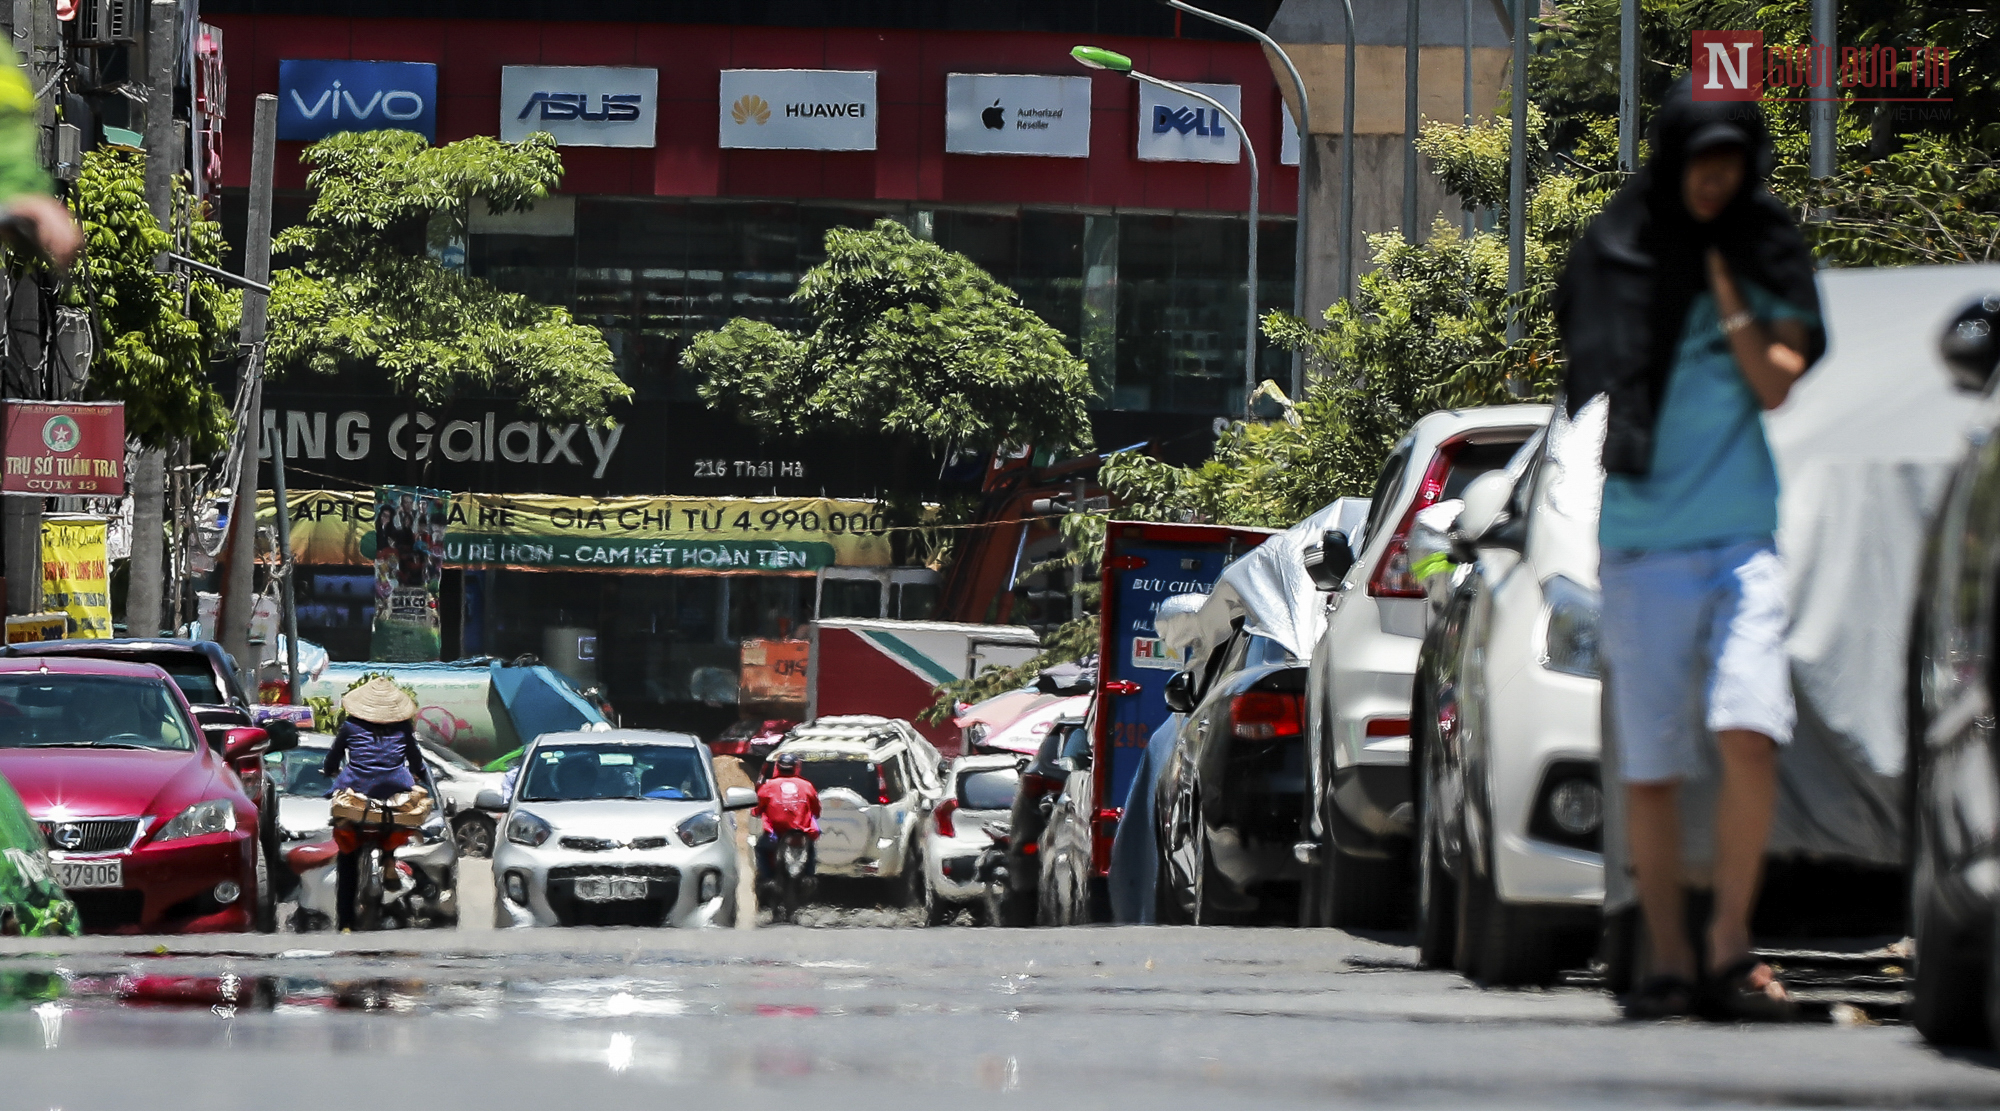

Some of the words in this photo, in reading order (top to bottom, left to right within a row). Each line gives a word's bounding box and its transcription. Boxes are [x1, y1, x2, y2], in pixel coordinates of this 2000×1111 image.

[517, 92, 642, 121] ASUS
[786, 103, 865, 118] HUAWEI
[1017, 107, 1063, 119] Authorized
[1016, 120, 1049, 130] Reseller
[1153, 105, 1225, 136] DELL
[388, 411, 625, 479] Galaxy
[6, 456, 31, 479] TRỤ
[34, 450, 53, 475] SỞ
[93, 459, 118, 478] TRA
[694, 459, 727, 477] 216
[733, 460, 773, 477] Thái
[26, 480, 72, 492] CỤM
[78, 481, 97, 490] 13
[575, 545, 629, 564] CAM
[634, 541, 676, 564] KẾT
[682, 543, 749, 567] HOÀN
[1133, 578, 1166, 592] BƯU
